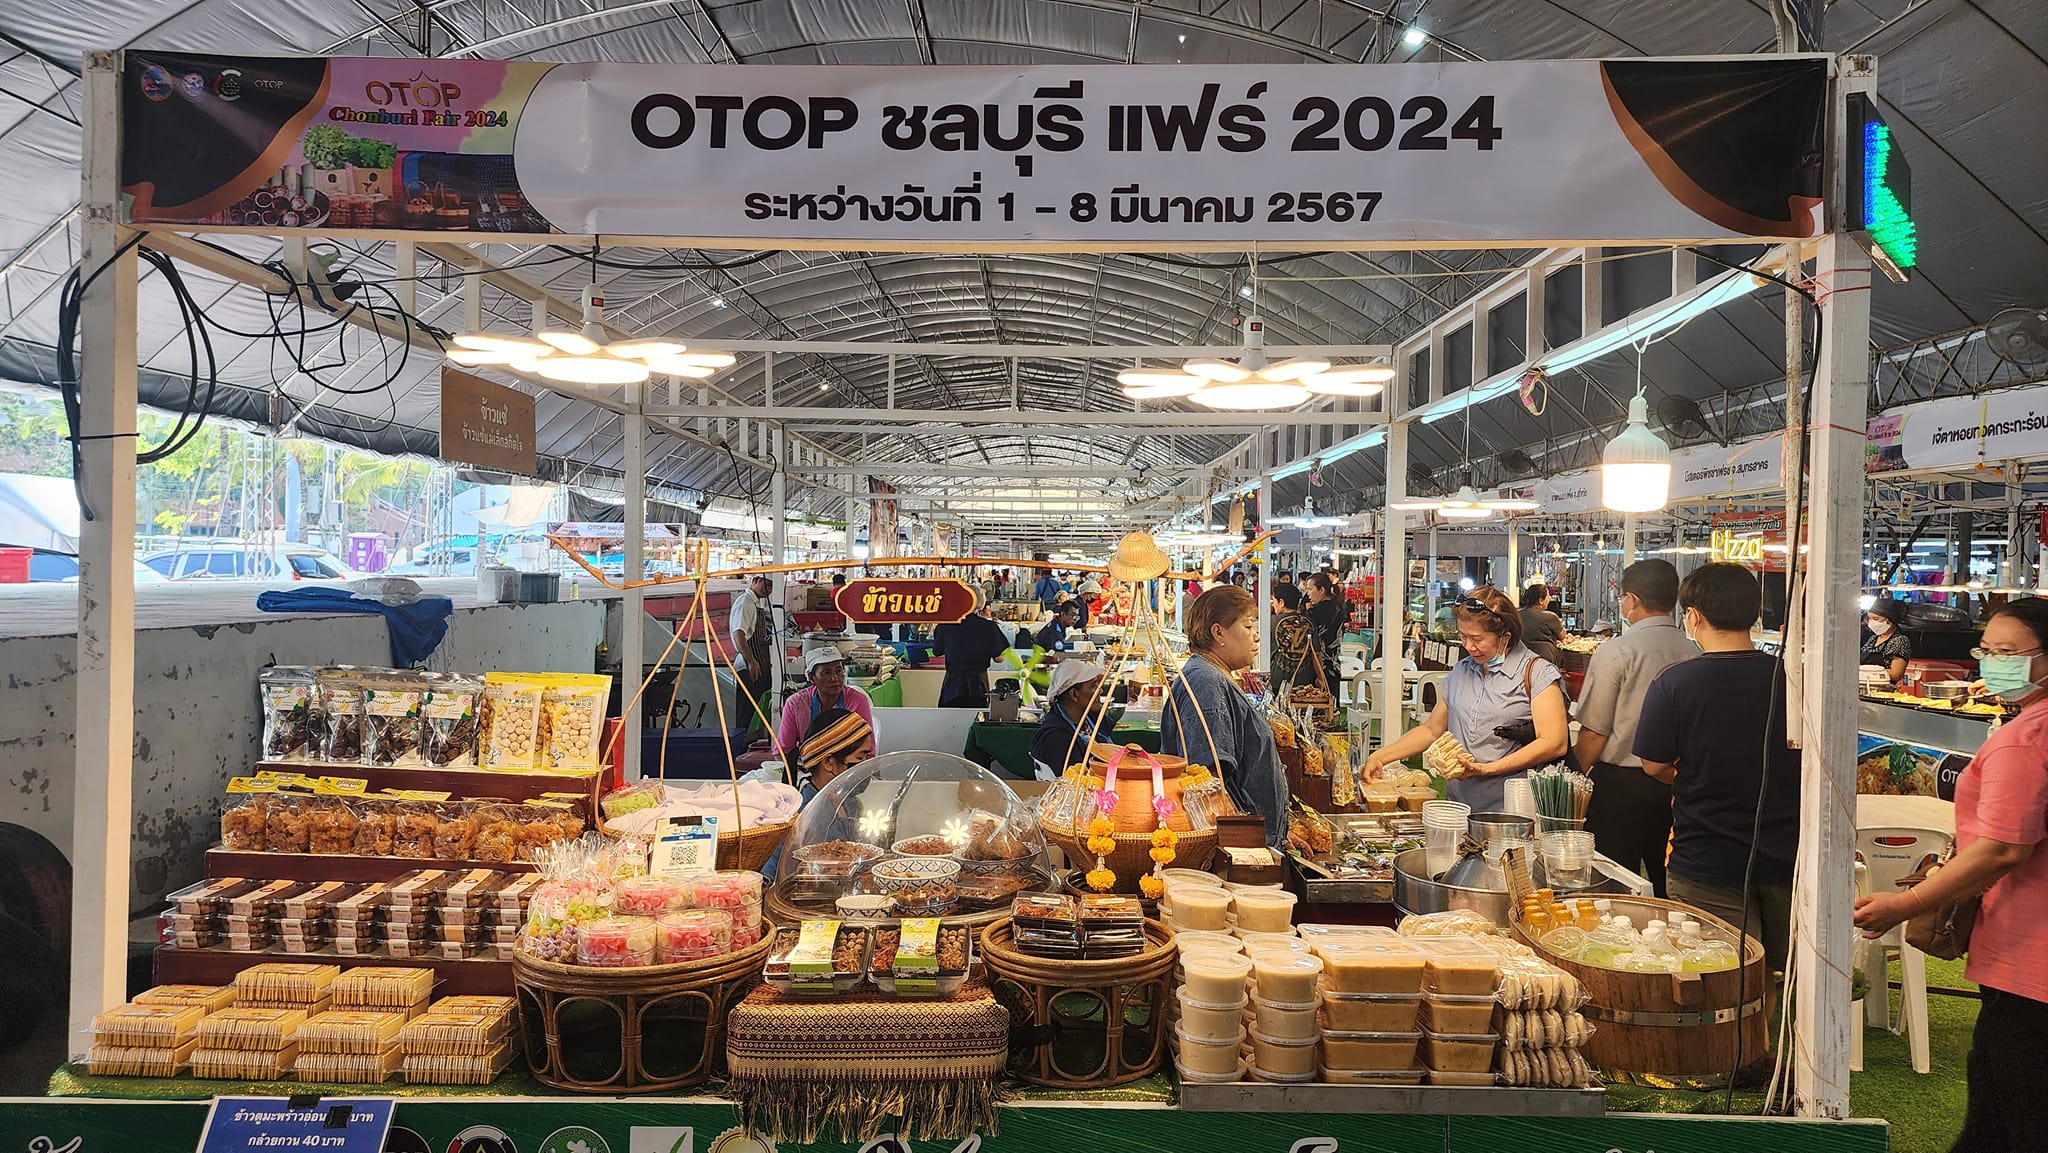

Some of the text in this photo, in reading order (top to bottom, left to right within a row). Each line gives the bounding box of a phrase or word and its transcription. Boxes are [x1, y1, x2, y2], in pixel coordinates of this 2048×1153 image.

[254, 79, 284, 89] OTOP
[365, 80, 461, 107] OTOP
[328, 106, 508, 127] Chonburi Fair 2024
[630, 80, 1503, 177] OTOP ชลบุรี แฟร์ 2024
[744, 171, 982, 222] ระหว่างวันที่
[997, 192, 1015, 222] 1
[1069, 192, 1098, 222] 8
[1110, 183, 1254, 223] มีนาคม
[1267, 192, 1383, 222] 2567
[480, 397, 508, 426] ข้าวแช่
[1711, 530, 1763, 560] Pizza
[862, 586, 943, 614] ข้าวแช่
[350, 1112, 374, 1122] บาท
[247, 1132, 346, 1147] กล้วยกวน 40 บาท
